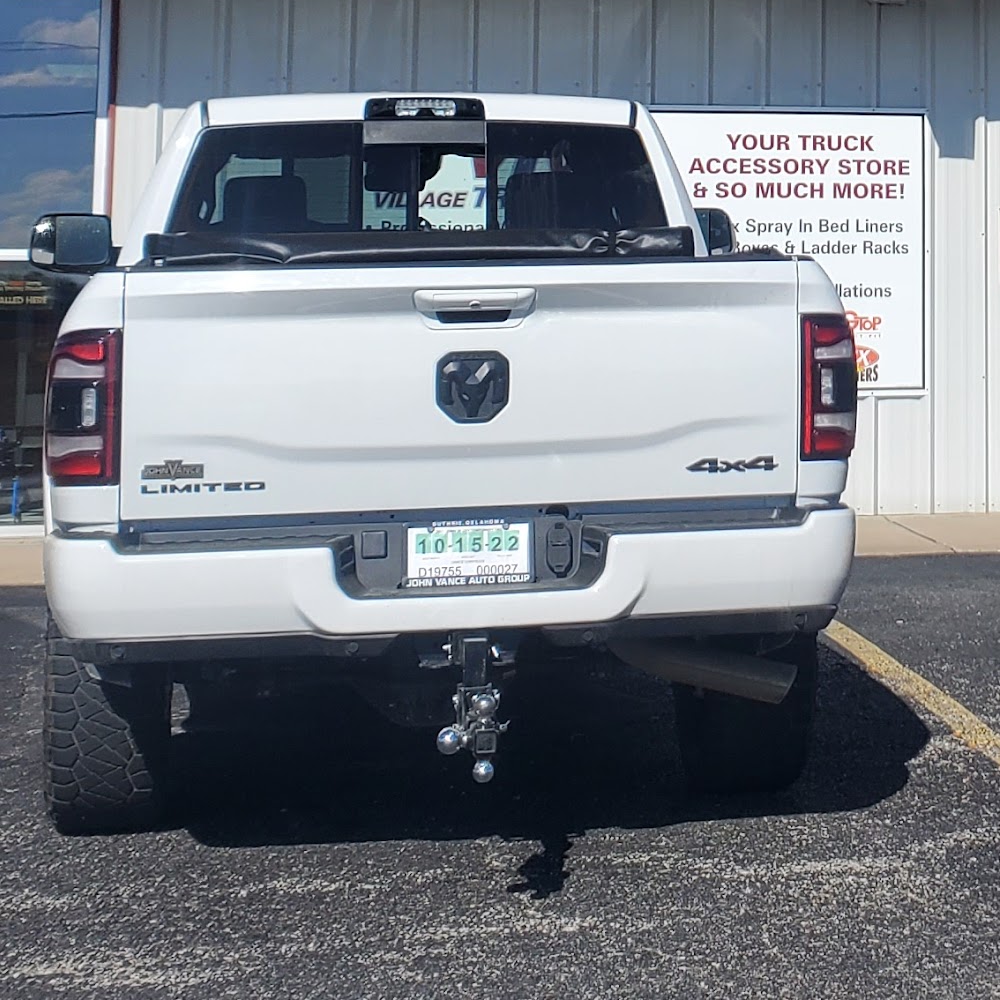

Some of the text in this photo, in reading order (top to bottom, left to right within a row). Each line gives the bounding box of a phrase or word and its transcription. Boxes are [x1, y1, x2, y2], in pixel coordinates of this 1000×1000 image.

[726, 133, 875, 152] YOUR TRUCK
[688, 158, 910, 176] ACCESSORY STORE
[374, 191, 468, 208] VILAGE
[693, 182, 906, 200] & SO MUCH MORE!
[745, 218, 793, 236] Spray
[799, 219, 813, 233] In
[818, 219, 850, 233] Bed
[855, 219, 904, 233] Liners
[784, 240, 796, 255] &
[801, 240, 858, 255] Ladder
[863, 241, 909, 255] Racks
[141, 481, 265, 494] LIMITED
[418, 563, 519, 578] D19755 000027
[406, 574, 530, 587] JOHN VANCE AUTO GROUP
